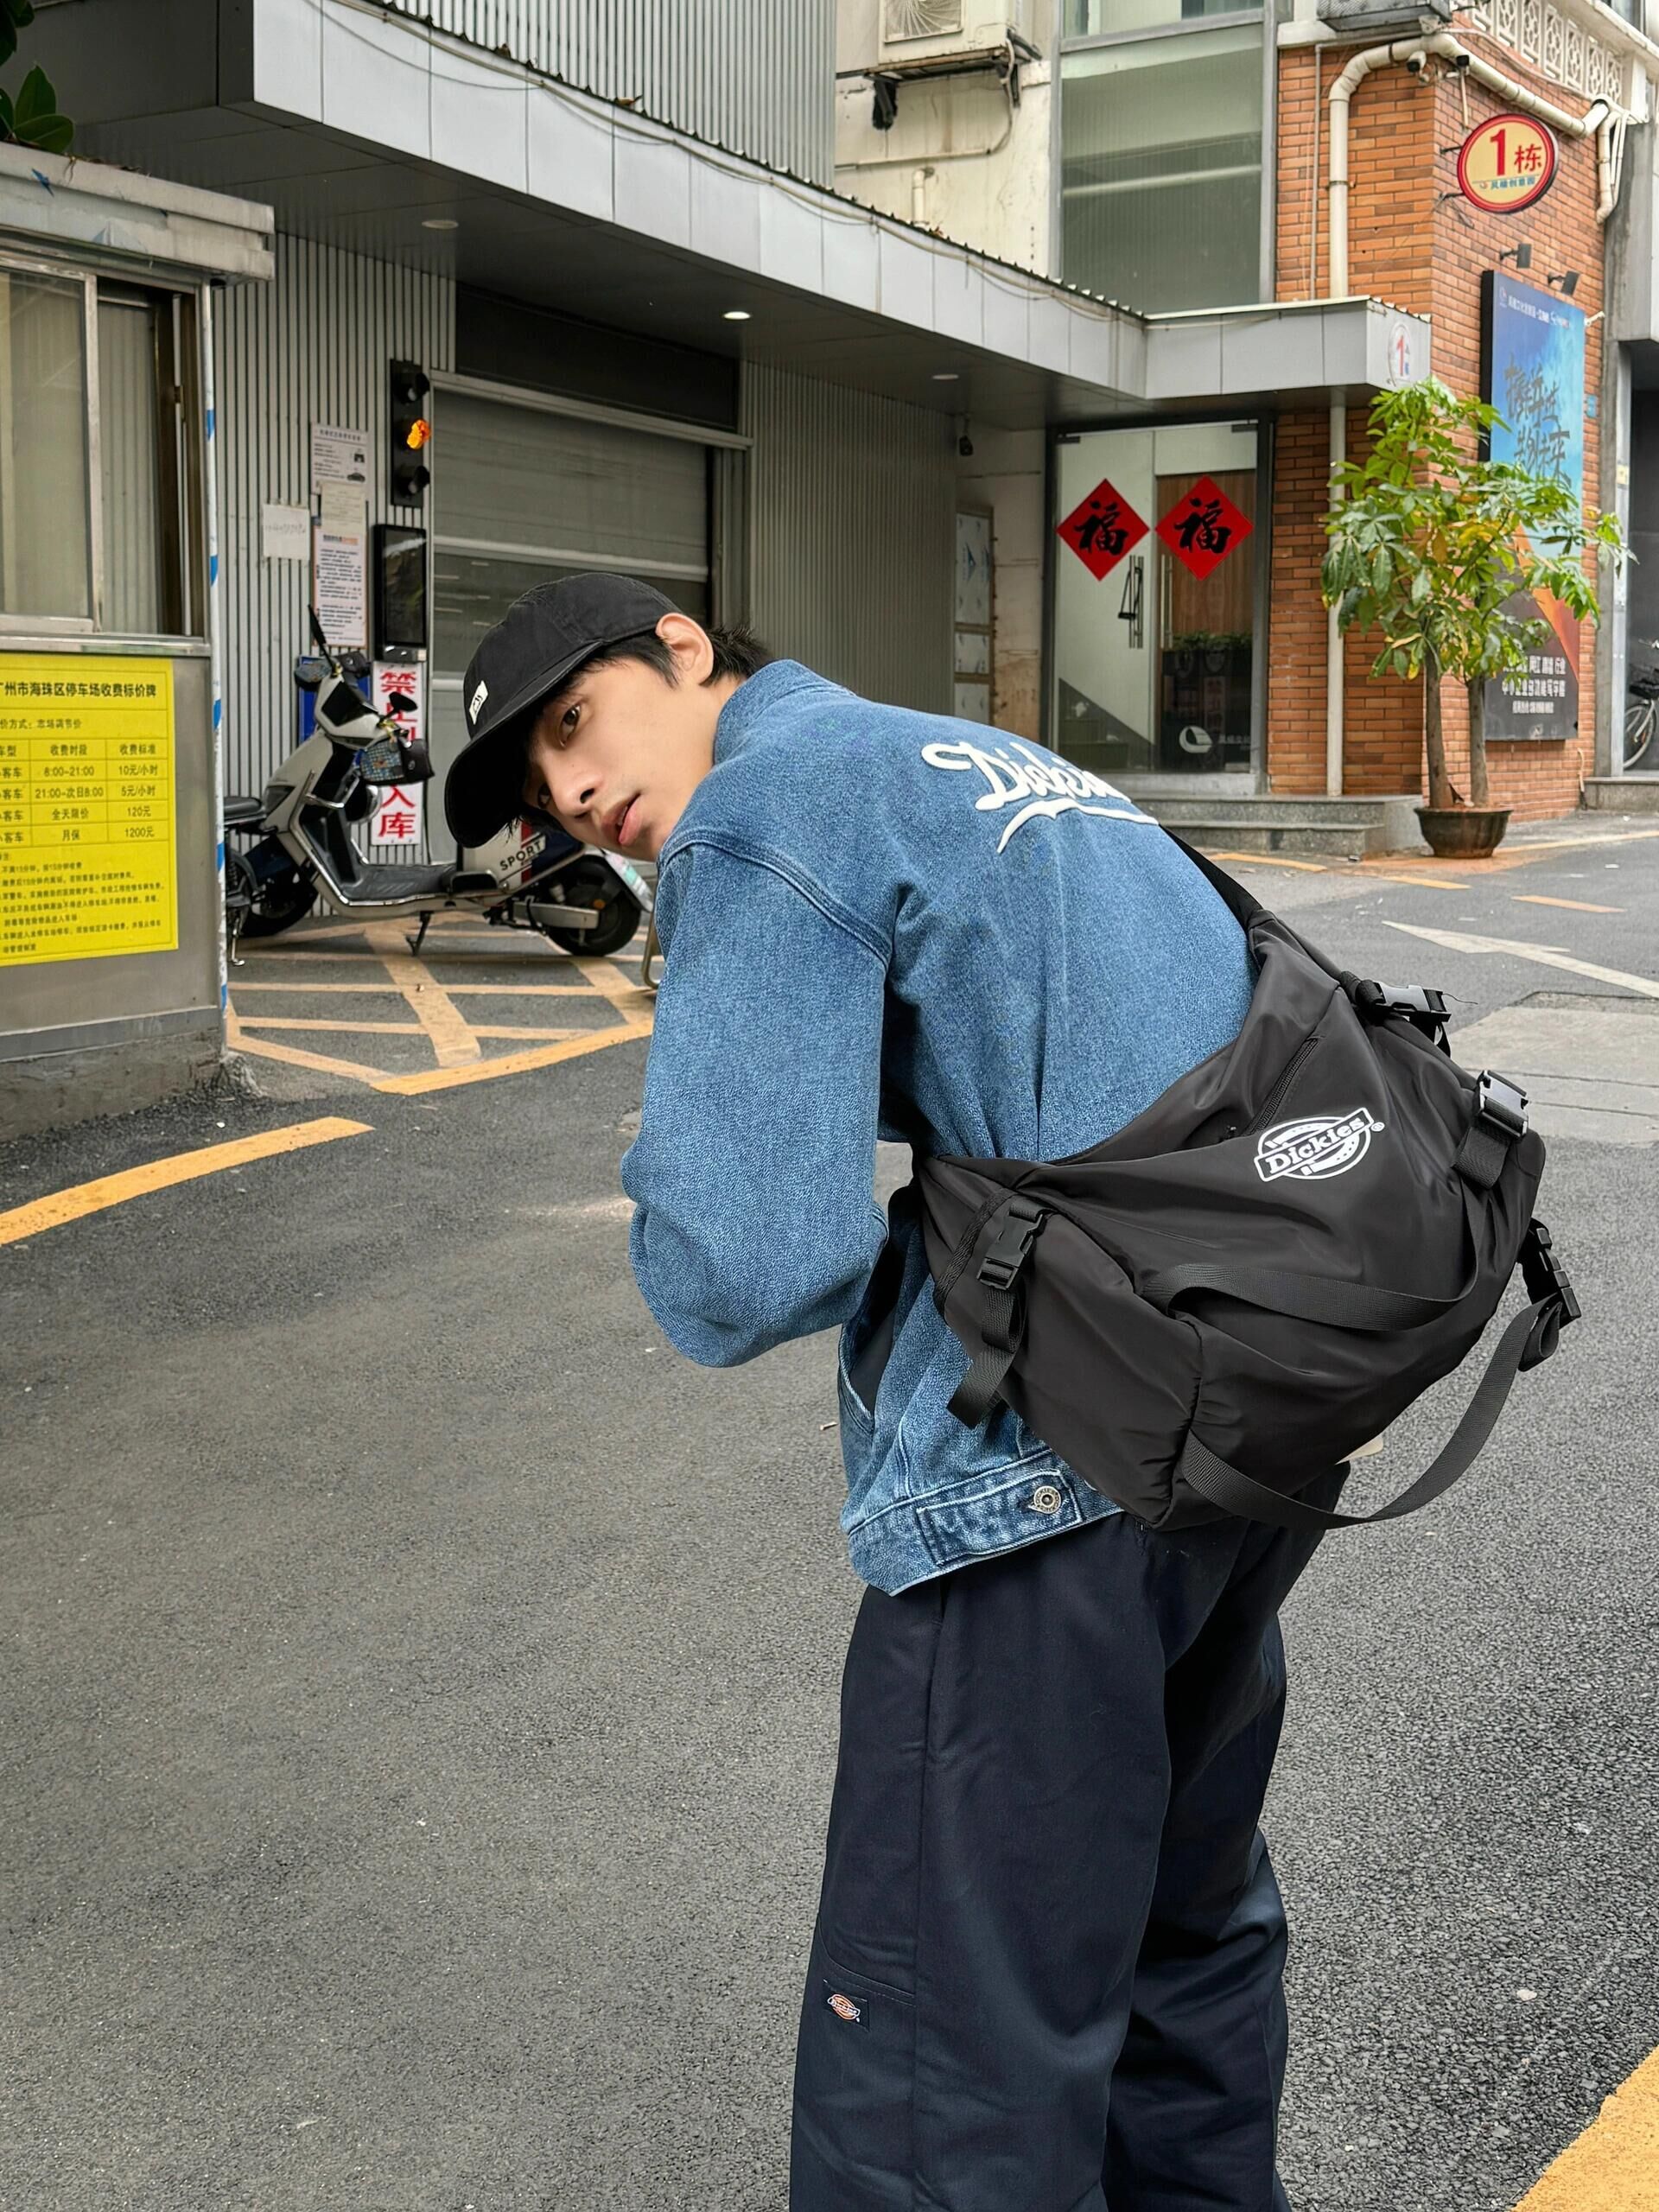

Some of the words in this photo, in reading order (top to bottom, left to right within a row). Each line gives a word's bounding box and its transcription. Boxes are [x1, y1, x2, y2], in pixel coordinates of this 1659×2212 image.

[1490, 129, 1542, 175] 1栋
[1074, 499, 1129, 556] 福
[1173, 498, 1231, 554] 福
[0, 766, 22, 778] 客车
[118, 765, 158, 776] 10元/小时
[0, 788, 22, 800] 客车
[121, 785, 156, 797] 5元/小时
[0, 810, 23, 821] 客车
[127, 805, 151, 817] 120元
[0, 831, 24, 842] 客车
[124, 826, 155, 838] 1200元
[499, 840, 542, 871] SPORT
[1265, 1117, 1365, 1174] Dickies
